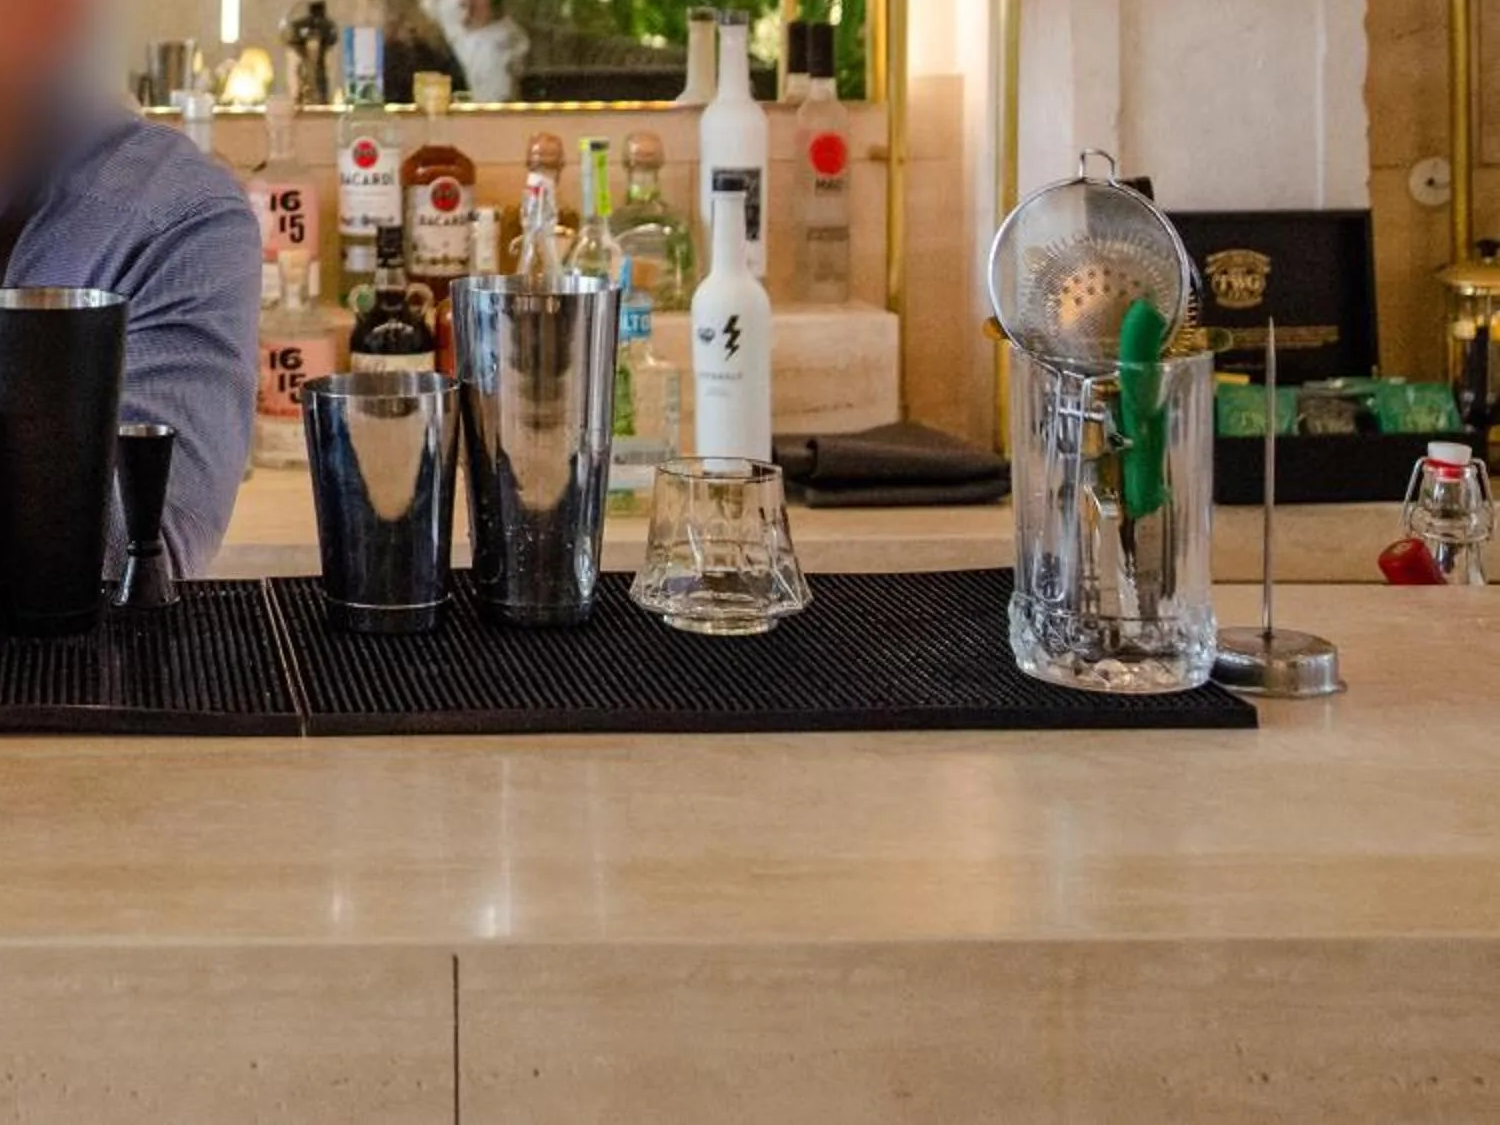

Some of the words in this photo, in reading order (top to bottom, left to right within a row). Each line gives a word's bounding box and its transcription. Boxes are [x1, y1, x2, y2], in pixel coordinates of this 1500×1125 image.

[270, 191, 301, 212] 16
[279, 214, 305, 243] 15
[268, 348, 303, 370] 16
[277, 374, 307, 404] 15
